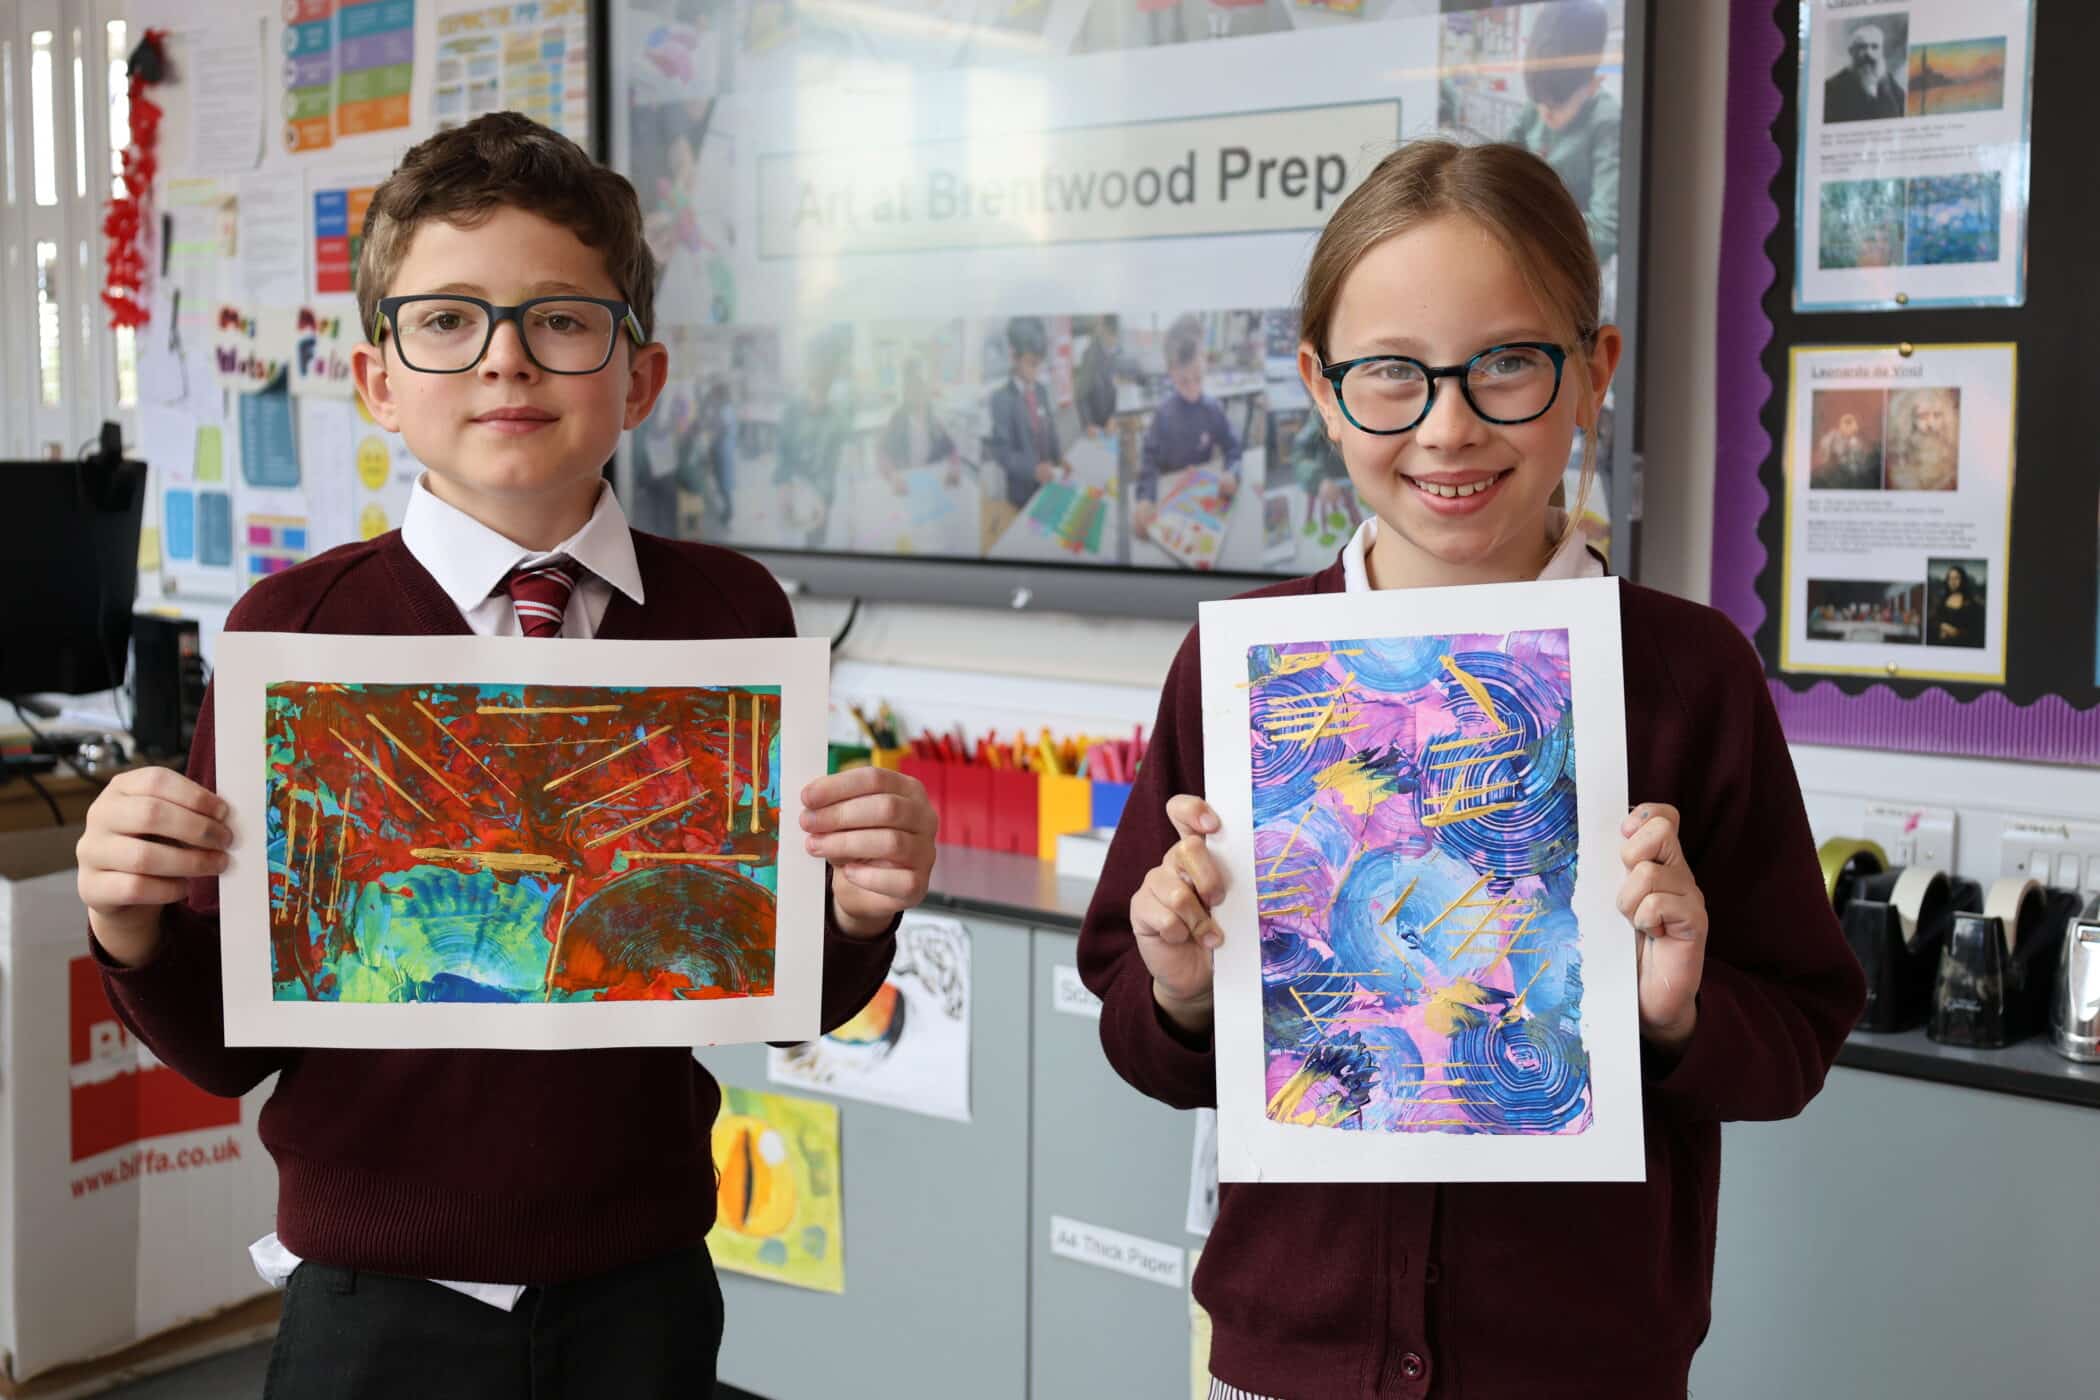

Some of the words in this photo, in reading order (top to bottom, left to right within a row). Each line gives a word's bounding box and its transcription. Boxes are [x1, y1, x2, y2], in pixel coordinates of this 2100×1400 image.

[926, 148, 1197, 223] Brentwood
[1217, 145, 1348, 211] Prep
[70, 1135, 241, 1198] www.biffa.co.uk
